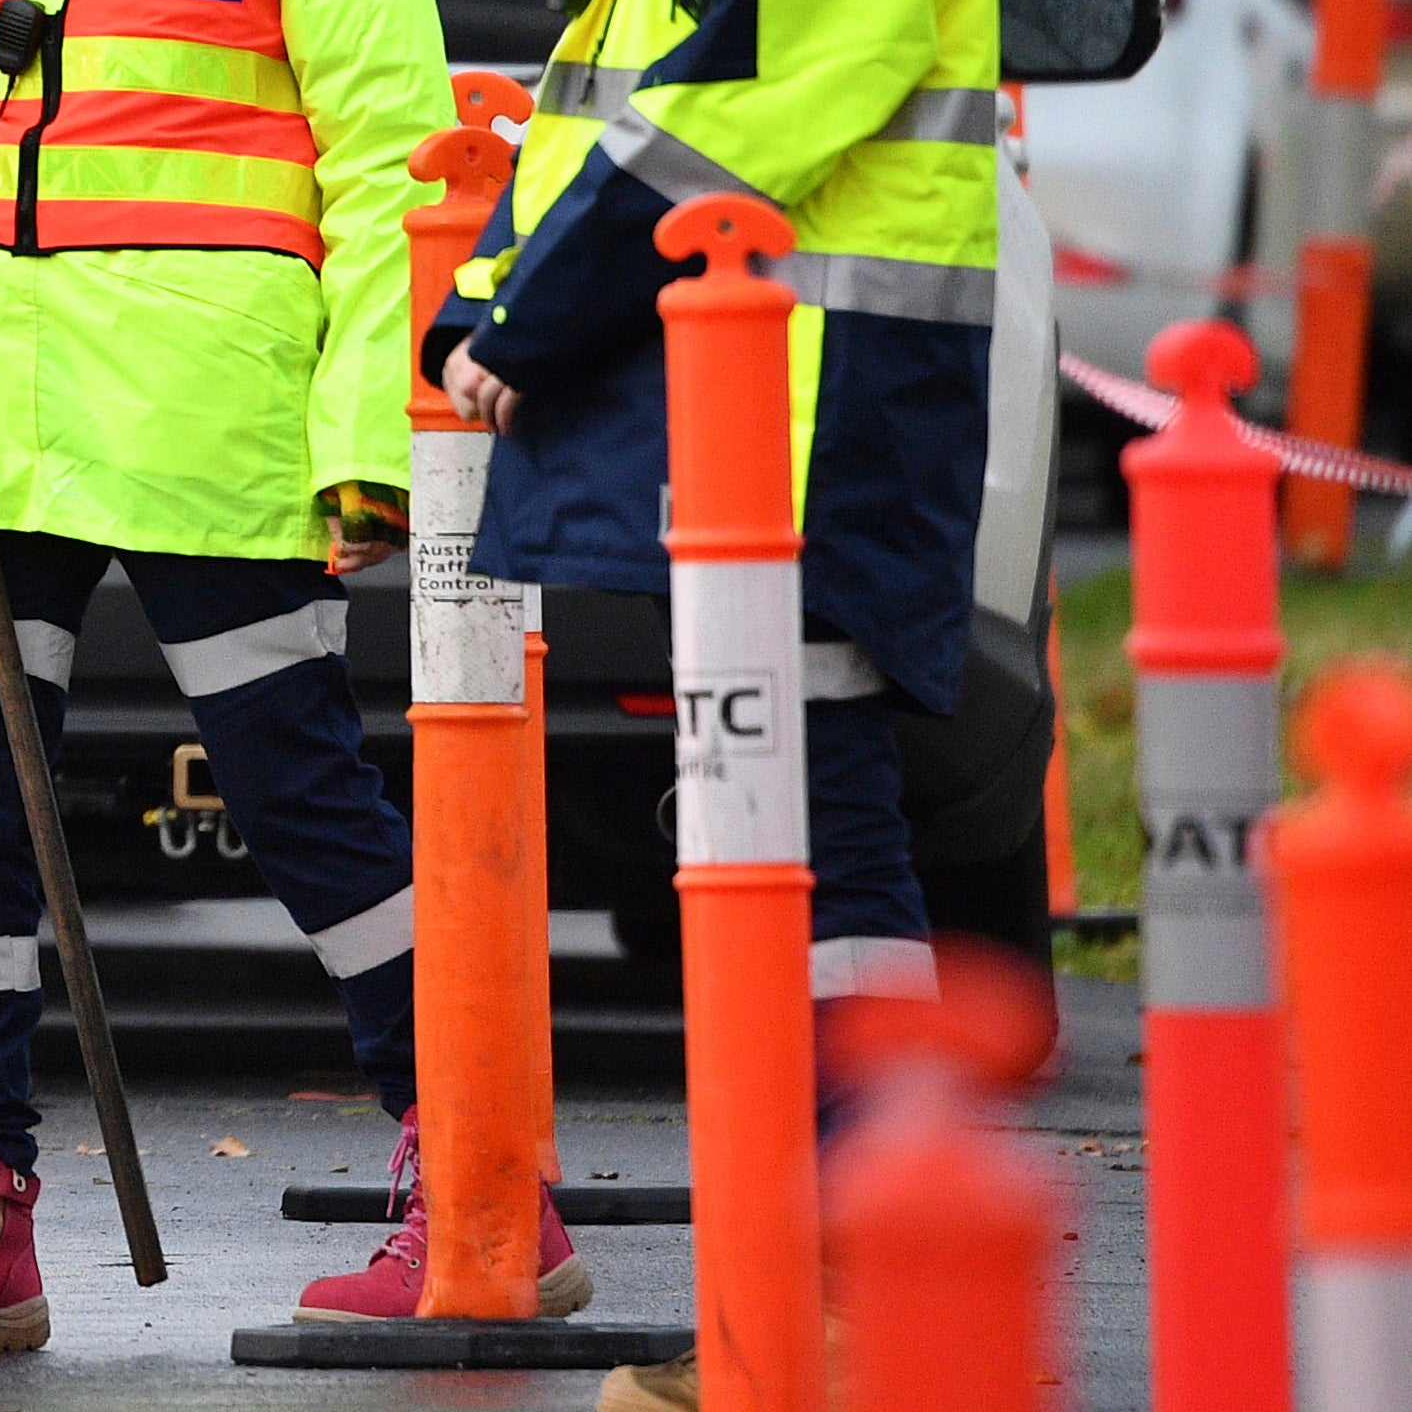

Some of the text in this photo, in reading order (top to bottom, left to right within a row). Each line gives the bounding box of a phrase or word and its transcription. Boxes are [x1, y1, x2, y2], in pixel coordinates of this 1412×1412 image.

[417, 543, 473, 557] Austr
[418, 559, 464, 573] Traff
[418, 575, 495, 591] Control
[676, 688, 764, 737] TC
